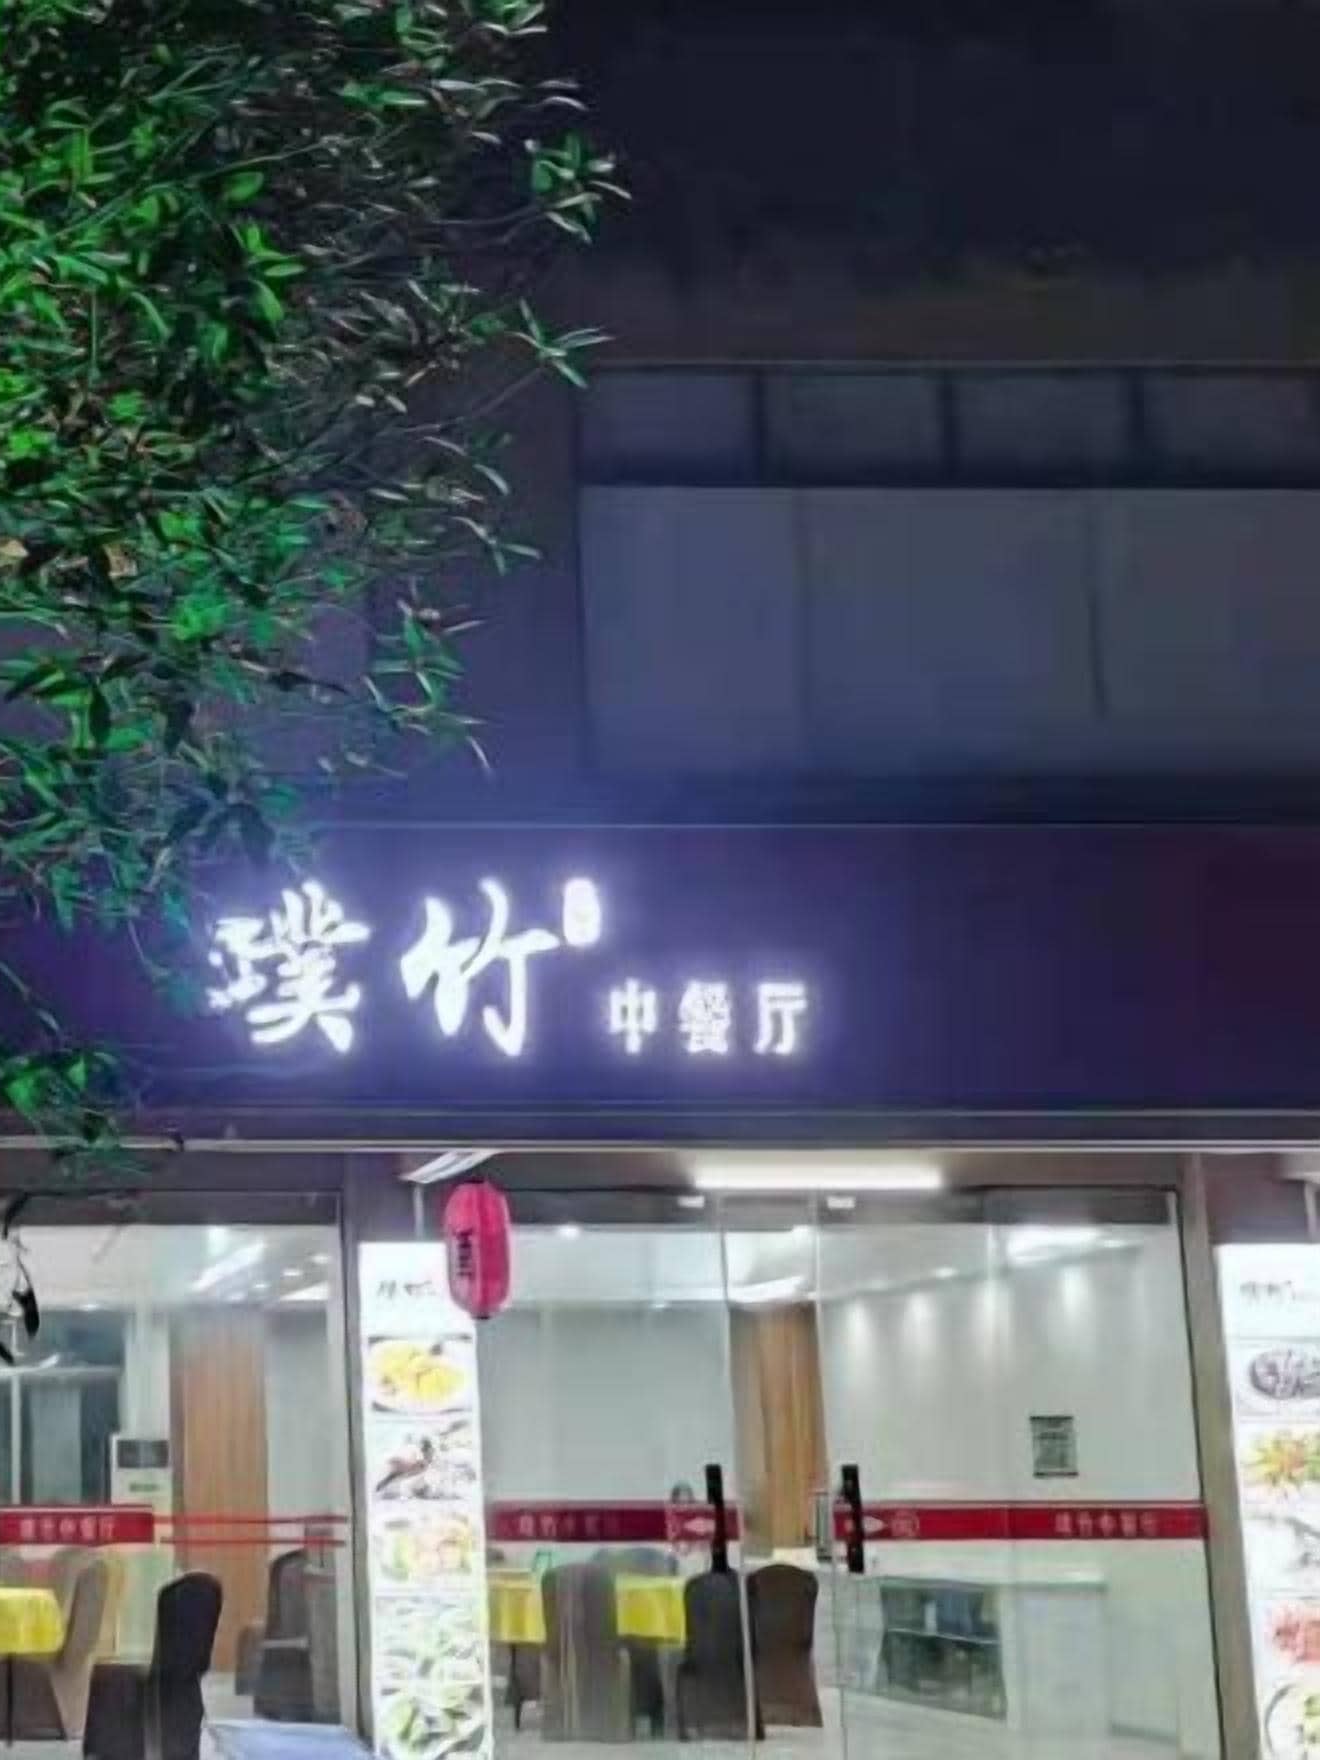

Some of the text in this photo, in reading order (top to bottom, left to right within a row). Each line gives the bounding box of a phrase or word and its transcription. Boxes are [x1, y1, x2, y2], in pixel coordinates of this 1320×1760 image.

[207, 879, 560, 1056] 璞竹
[607, 977, 808, 1055] 中餐厅
